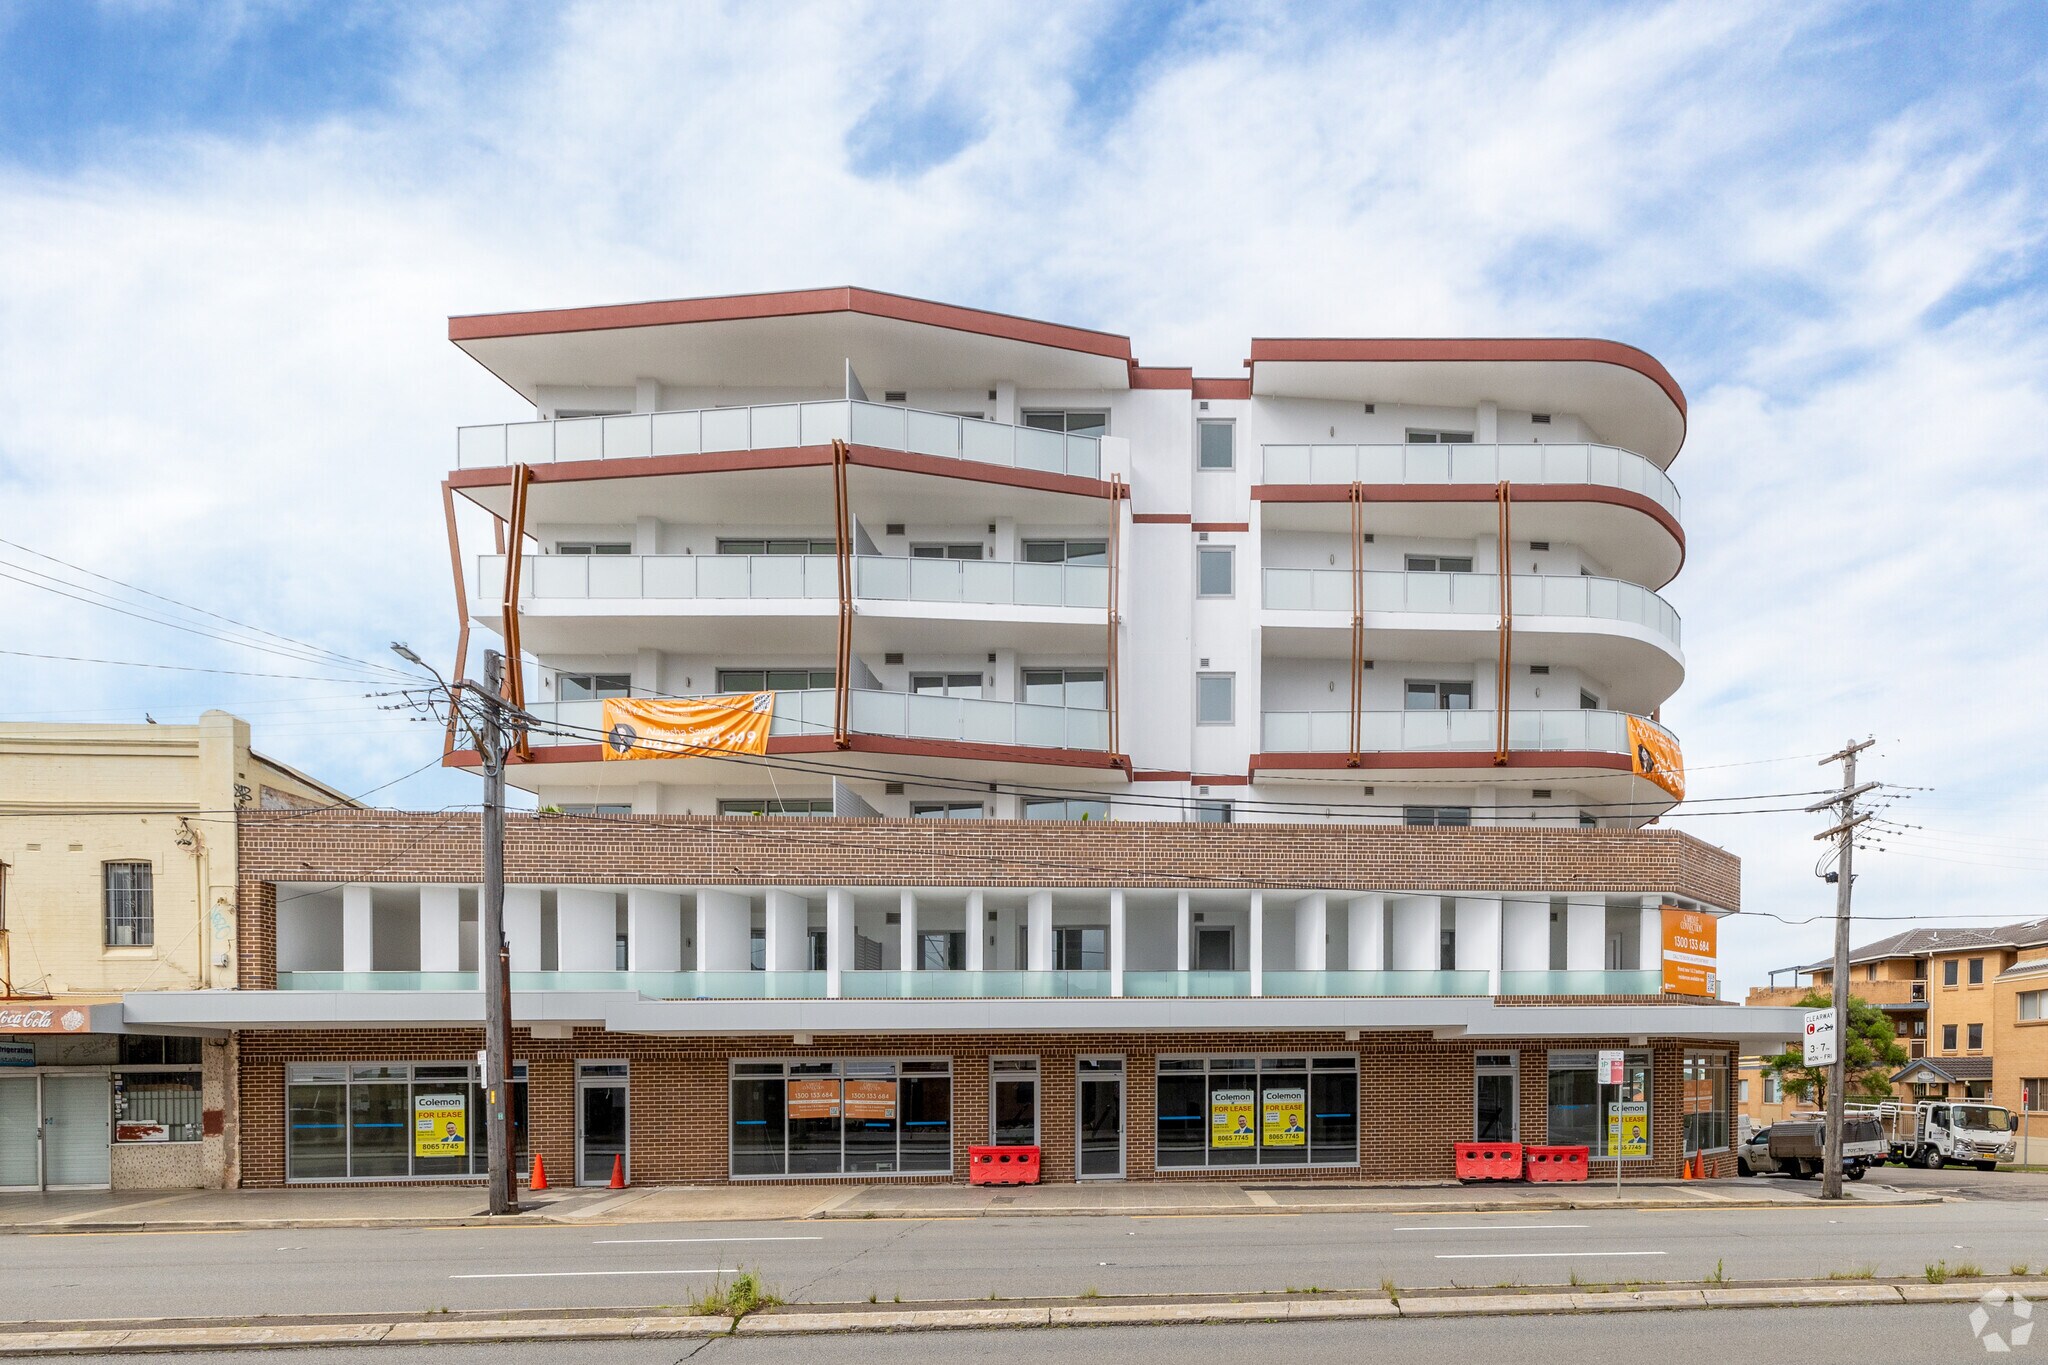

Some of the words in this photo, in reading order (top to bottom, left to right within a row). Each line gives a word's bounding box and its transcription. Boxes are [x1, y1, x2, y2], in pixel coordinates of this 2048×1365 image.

[646, 727, 687, 737] Natasha
[1674, 936, 1688, 949] 1300
[1806, 1012, 1833, 1023] CLEARWAY
[418, 1098, 460, 1107] Colemon
